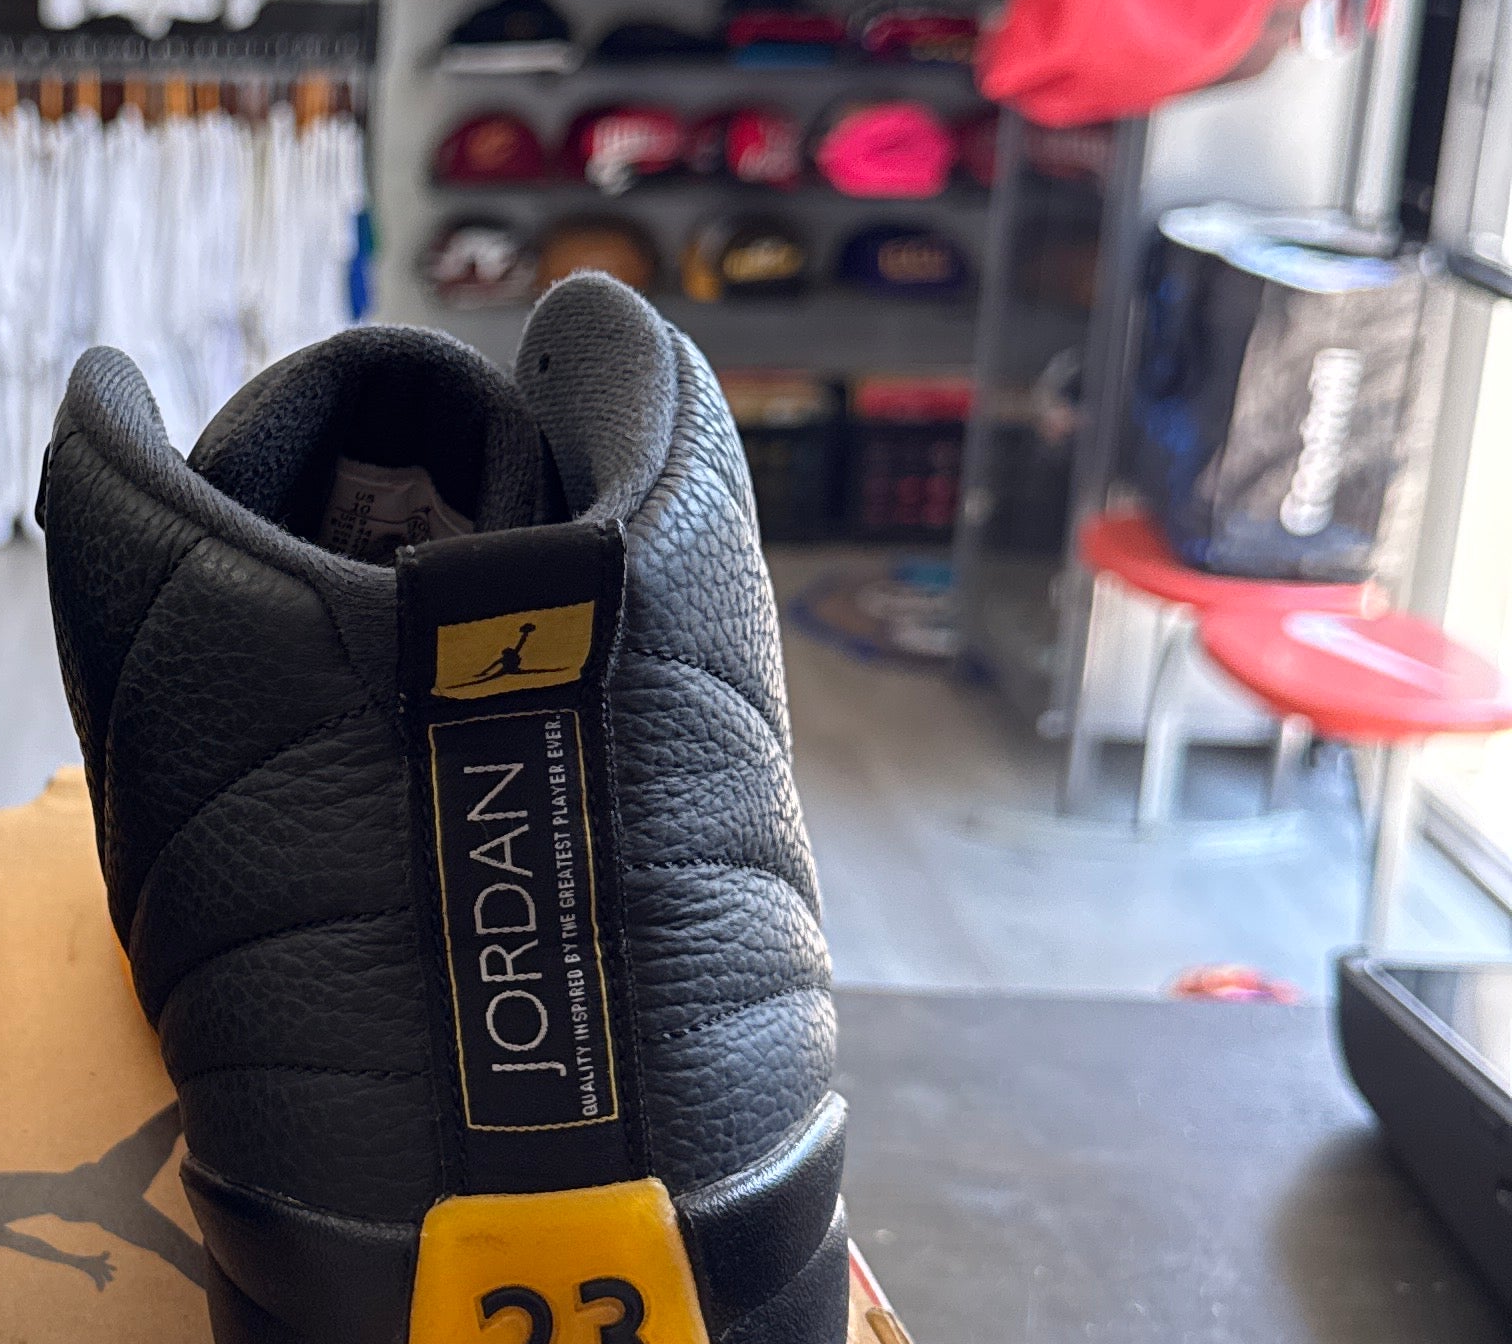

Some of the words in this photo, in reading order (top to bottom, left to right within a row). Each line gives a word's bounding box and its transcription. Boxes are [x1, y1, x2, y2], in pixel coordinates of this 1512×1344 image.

[544, 714, 564, 758] EVER.
[548, 763, 569, 825] PLAYER
[553, 832, 576, 908] GREATEST
[463, 762, 567, 1078] JORDAN
[560, 913, 577, 938] THE
[562, 941, 581, 964] BY
[567, 969, 591, 1041] INSPIRED
[575, 1044, 599, 1117] QUALITY
